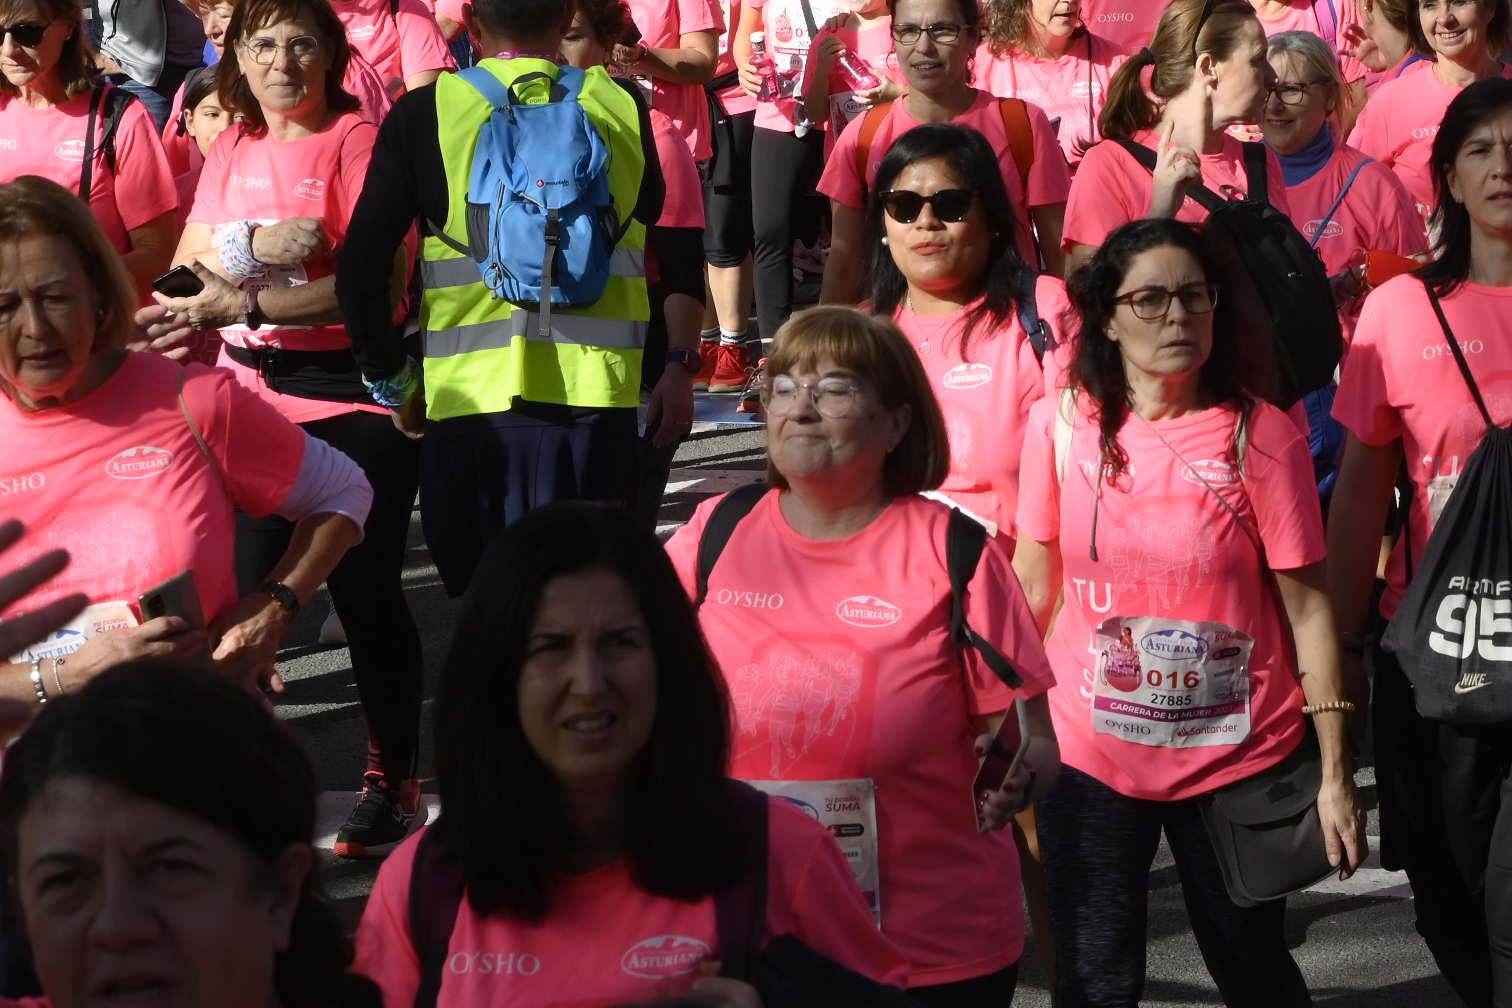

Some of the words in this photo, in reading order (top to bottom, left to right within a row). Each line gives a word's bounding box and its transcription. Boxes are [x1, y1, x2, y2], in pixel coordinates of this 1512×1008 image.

[1098, 11, 1134, 23] OYSHO
[0, 472, 46, 493] SHO
[717, 588, 784, 611] OYSHO
[1072, 577, 1112, 614] TU
[841, 604, 898, 623] ASTURIANA
[1146, 669, 1200, 689] 016
[1460, 673, 1487, 686] NIKE
[1150, 693, 1192, 707] 27885
[1110, 702, 1152, 717] CARRERA
[1153, 711, 1167, 720] DE
[1168, 711, 1180, 720] LA
[1105, 718, 1152, 736] OYSHO
[1190, 724, 1238, 735] Santander
[824, 802, 862, 813] SUMA
